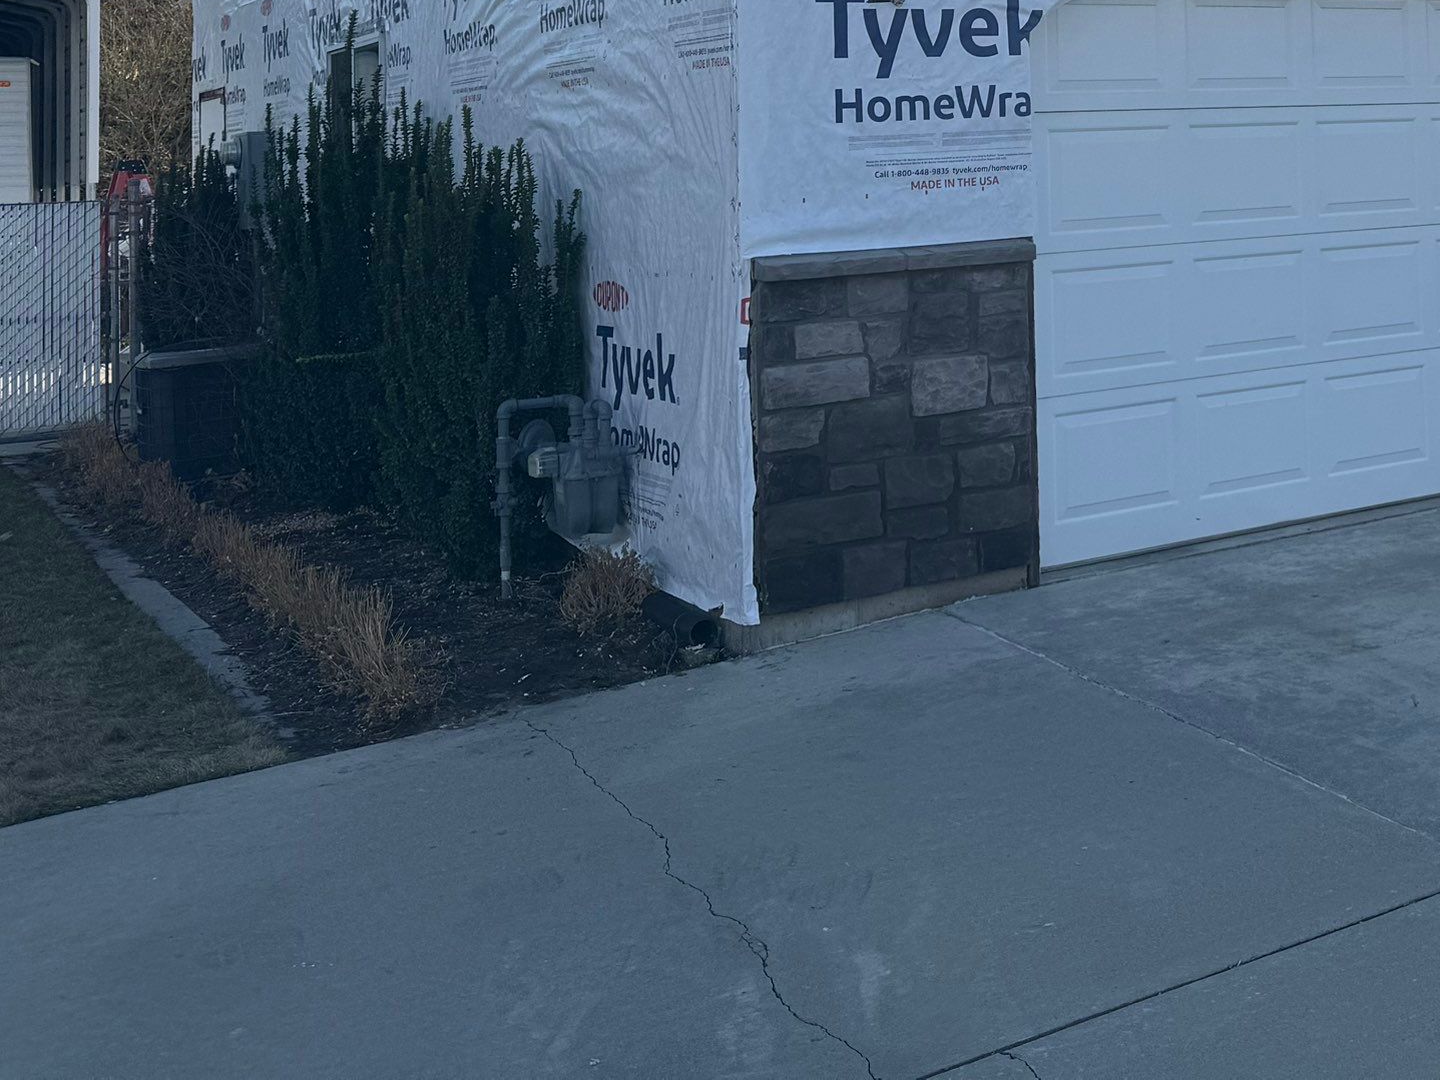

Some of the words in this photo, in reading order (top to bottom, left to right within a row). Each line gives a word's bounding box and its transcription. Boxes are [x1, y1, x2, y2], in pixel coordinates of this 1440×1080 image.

[221, 33, 245, 83] Tyvek
[262, 18, 289, 73] Tyvek
[444, 21, 495, 56] HomeWrap
[835, 84, 1032, 124] HomeWra
[875, 170, 890, 179] Call
[891, 167, 950, 178] 1-800-448-9835
[952, 164, 1028, 176] tyvek.com/homewrap
[910, 179, 942, 190] MADE
[944, 178, 954, 188] IN
[956, 177, 977, 188] THE
[979, 176, 1000, 186] USA
[596, 281, 625, 312] DUPONT
[596, 325, 676, 411] Tyvek
[610, 425, 680, 477] omeWrap
